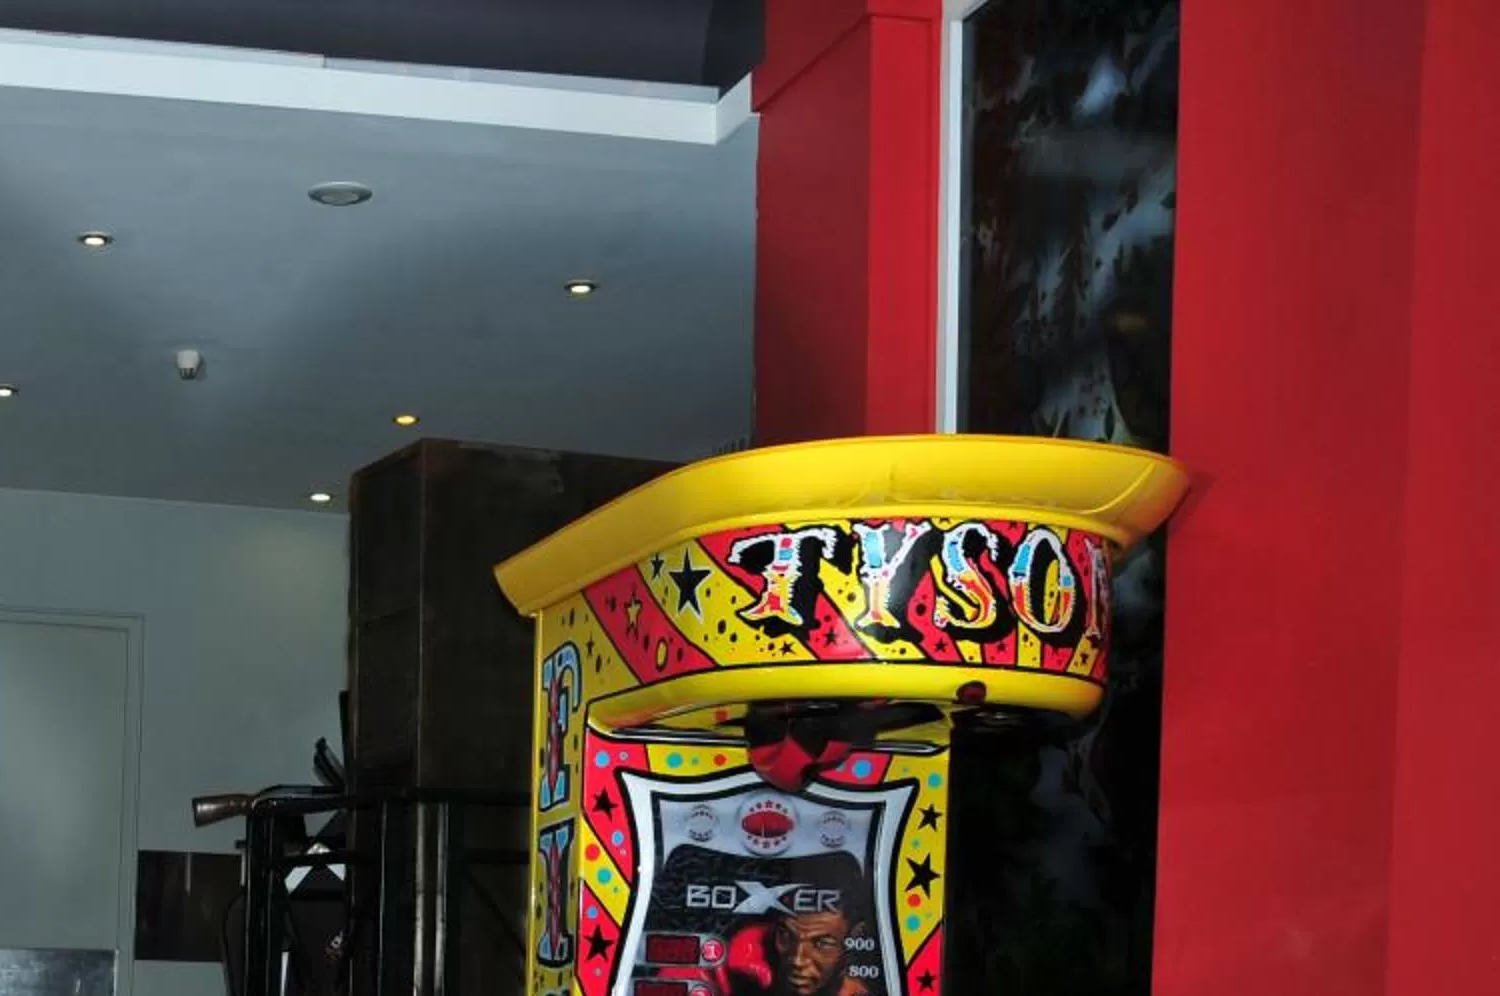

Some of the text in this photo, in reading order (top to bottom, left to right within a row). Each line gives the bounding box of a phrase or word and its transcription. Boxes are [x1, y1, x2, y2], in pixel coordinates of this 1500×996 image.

[686, 880, 842, 916] BOXER
[843, 938, 875, 951] 900
[848, 965, 879, 978] 800
